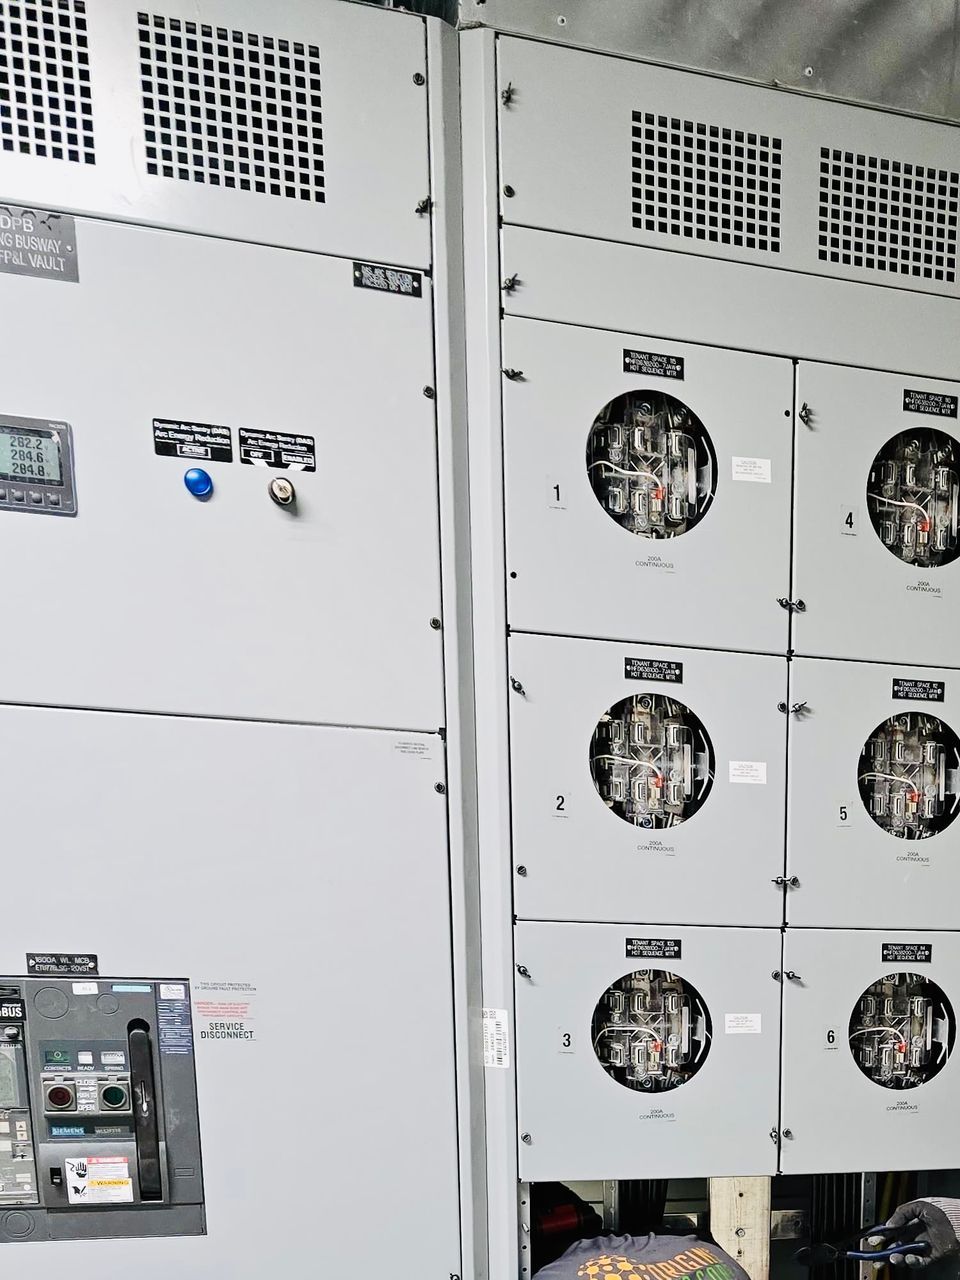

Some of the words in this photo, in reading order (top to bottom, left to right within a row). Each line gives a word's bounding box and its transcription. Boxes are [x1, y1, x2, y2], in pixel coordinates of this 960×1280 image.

[15, 234, 61, 254] BUSWAY
[28, 252, 66, 272] VAULT
[630, 352, 649, 360] TENANT
[652, 355, 667, 364] SPACE
[642, 366, 664, 375] SEQUENCE
[10, 436, 43, 451] 282.2
[169, 431, 194, 441] Energy
[195, 434, 230, 444] Reduction
[258, 440, 278, 448] Energy
[11, 449, 44, 463] 284.6
[12, 463, 45, 477] 284.8
[553, 484, 560, 502] 1
[845, 511, 854, 529] 4
[635, 560, 674, 569] CONTINUOUS
[906, 584, 941, 593] CONTINUOUS
[653, 661, 668, 669] SPACE
[556, 795, 565, 811] 2
[839, 806, 848, 821] 5
[637, 844, 675, 852] CONTINUOUS
[35, 956, 57, 964] 1600A
[0, 1007, 22, 1018] BUS
[209, 1022, 245, 1031] SERVICE
[200, 1031, 254, 1039] DISCONNECT
[562, 1033, 571, 1048] 3
[827, 1029, 835, 1044] 6
[639, 1112, 675, 1120] CONTINUOUS
[52, 1127, 85, 1135] SIEMENS
